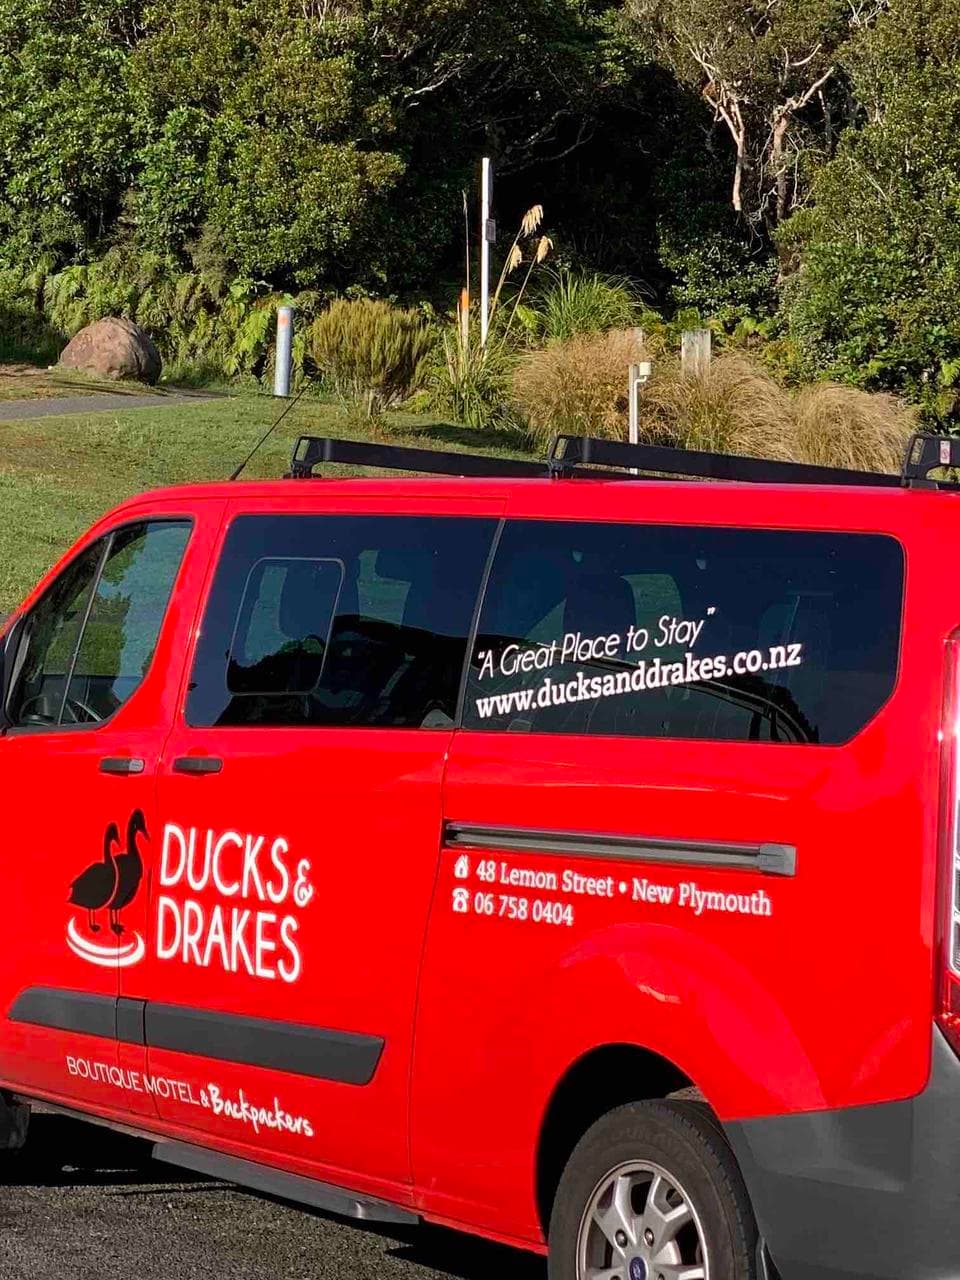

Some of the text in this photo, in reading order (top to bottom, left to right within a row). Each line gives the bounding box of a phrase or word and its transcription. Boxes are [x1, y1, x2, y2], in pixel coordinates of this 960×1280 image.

[500, 644, 556, 677] Great
[561, 632, 619, 662] Place
[627, 626, 648, 652] to
[476, 643, 802, 718] www.ducksanddrakes.co.nz
[474, 894, 573, 926] 06 758 0404
[476, 860, 772, 916] 48 Lemon Street New Plymouth
[156, 896, 301, 983] DRAKES
[66, 1056, 143, 1092] BOUTIQUE
[143, 1075, 200, 1105] MOTEL
